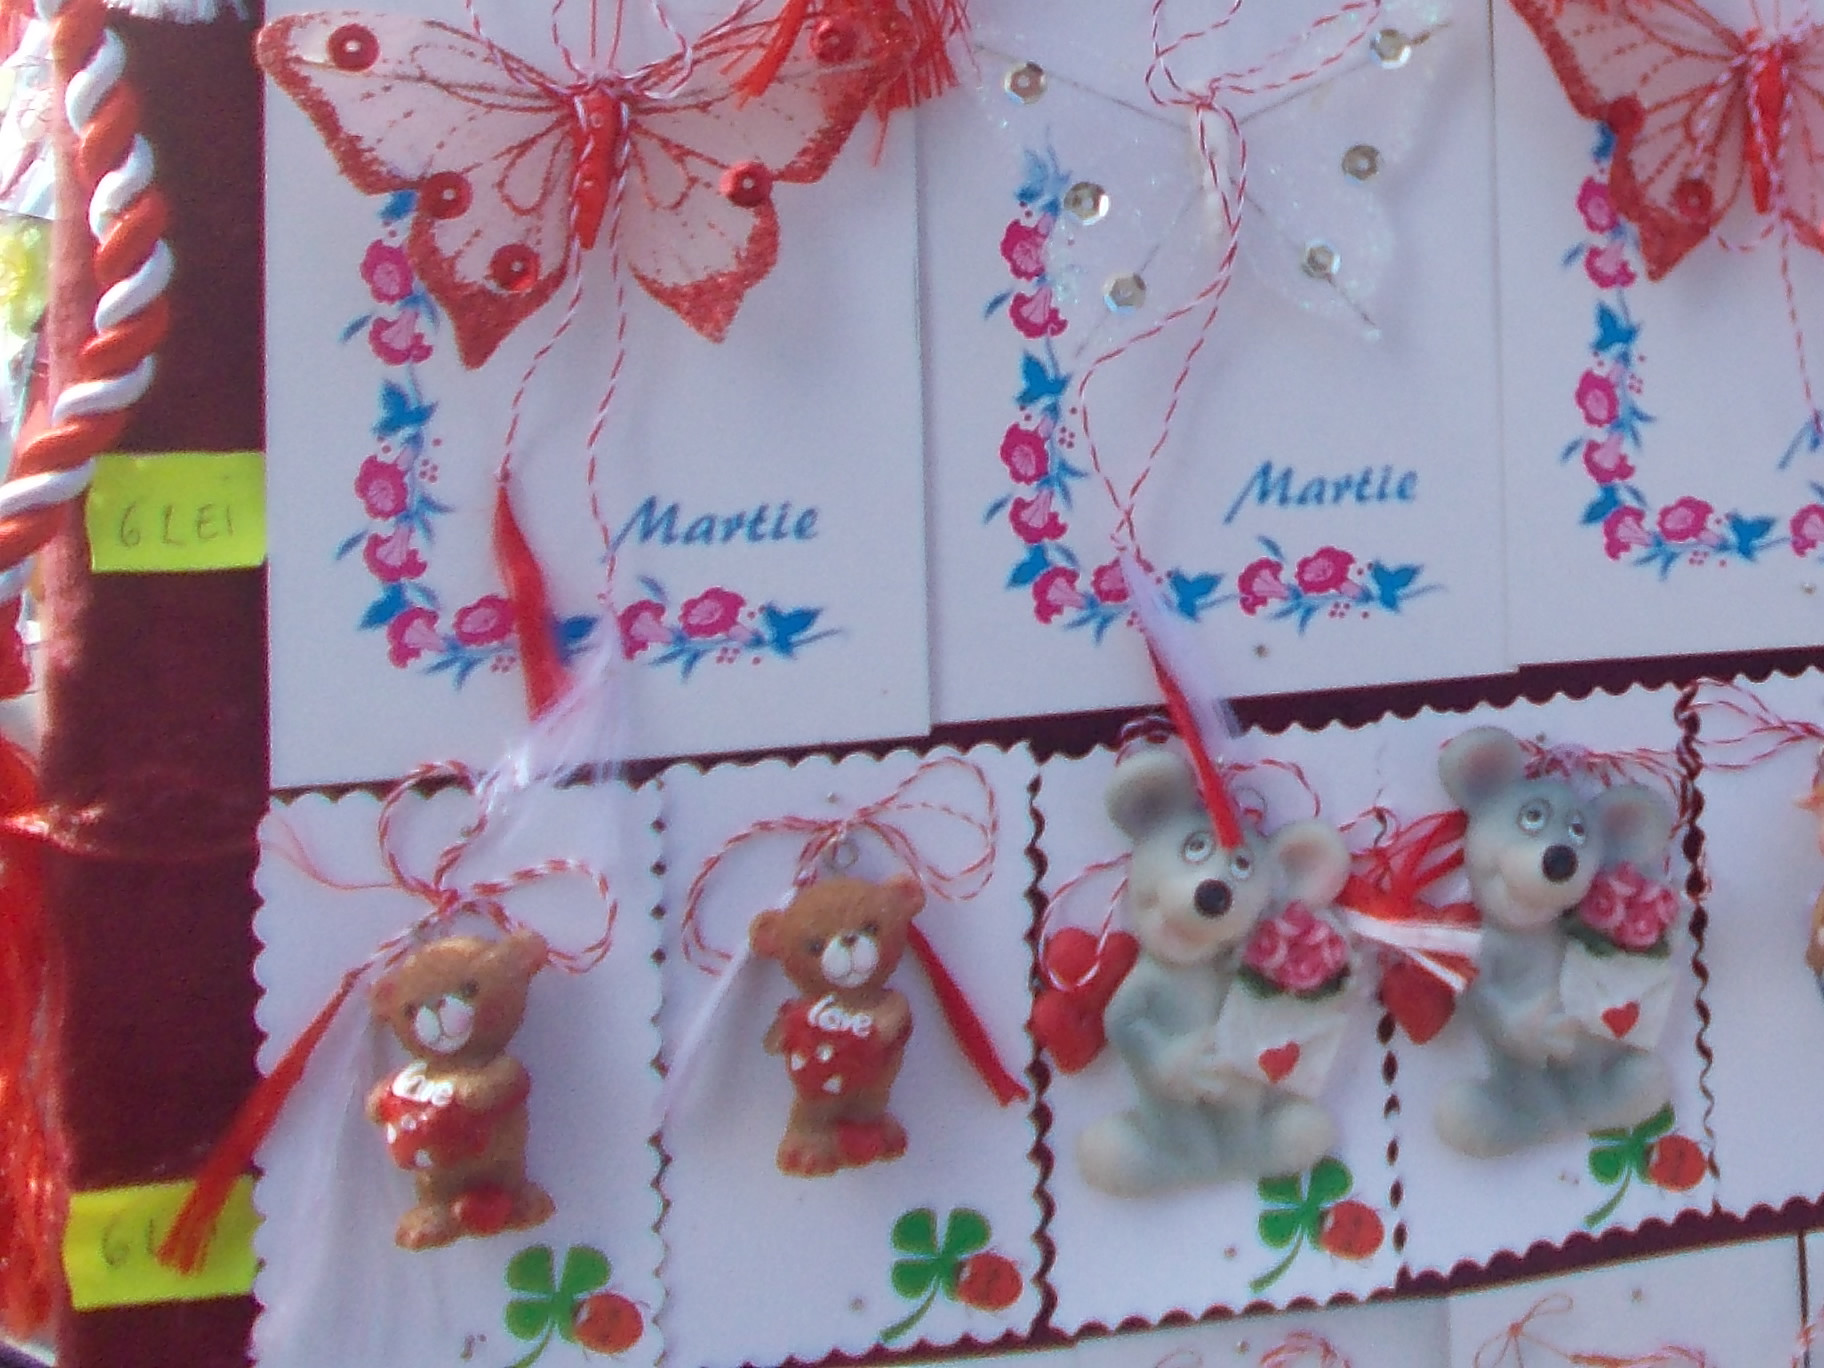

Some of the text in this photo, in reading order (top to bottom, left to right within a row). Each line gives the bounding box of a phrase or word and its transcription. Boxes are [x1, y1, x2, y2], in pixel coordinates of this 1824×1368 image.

[118, 500, 142, 548] 6
[1222, 460, 1419, 525] Martie
[600, 495, 818, 563] Martie
